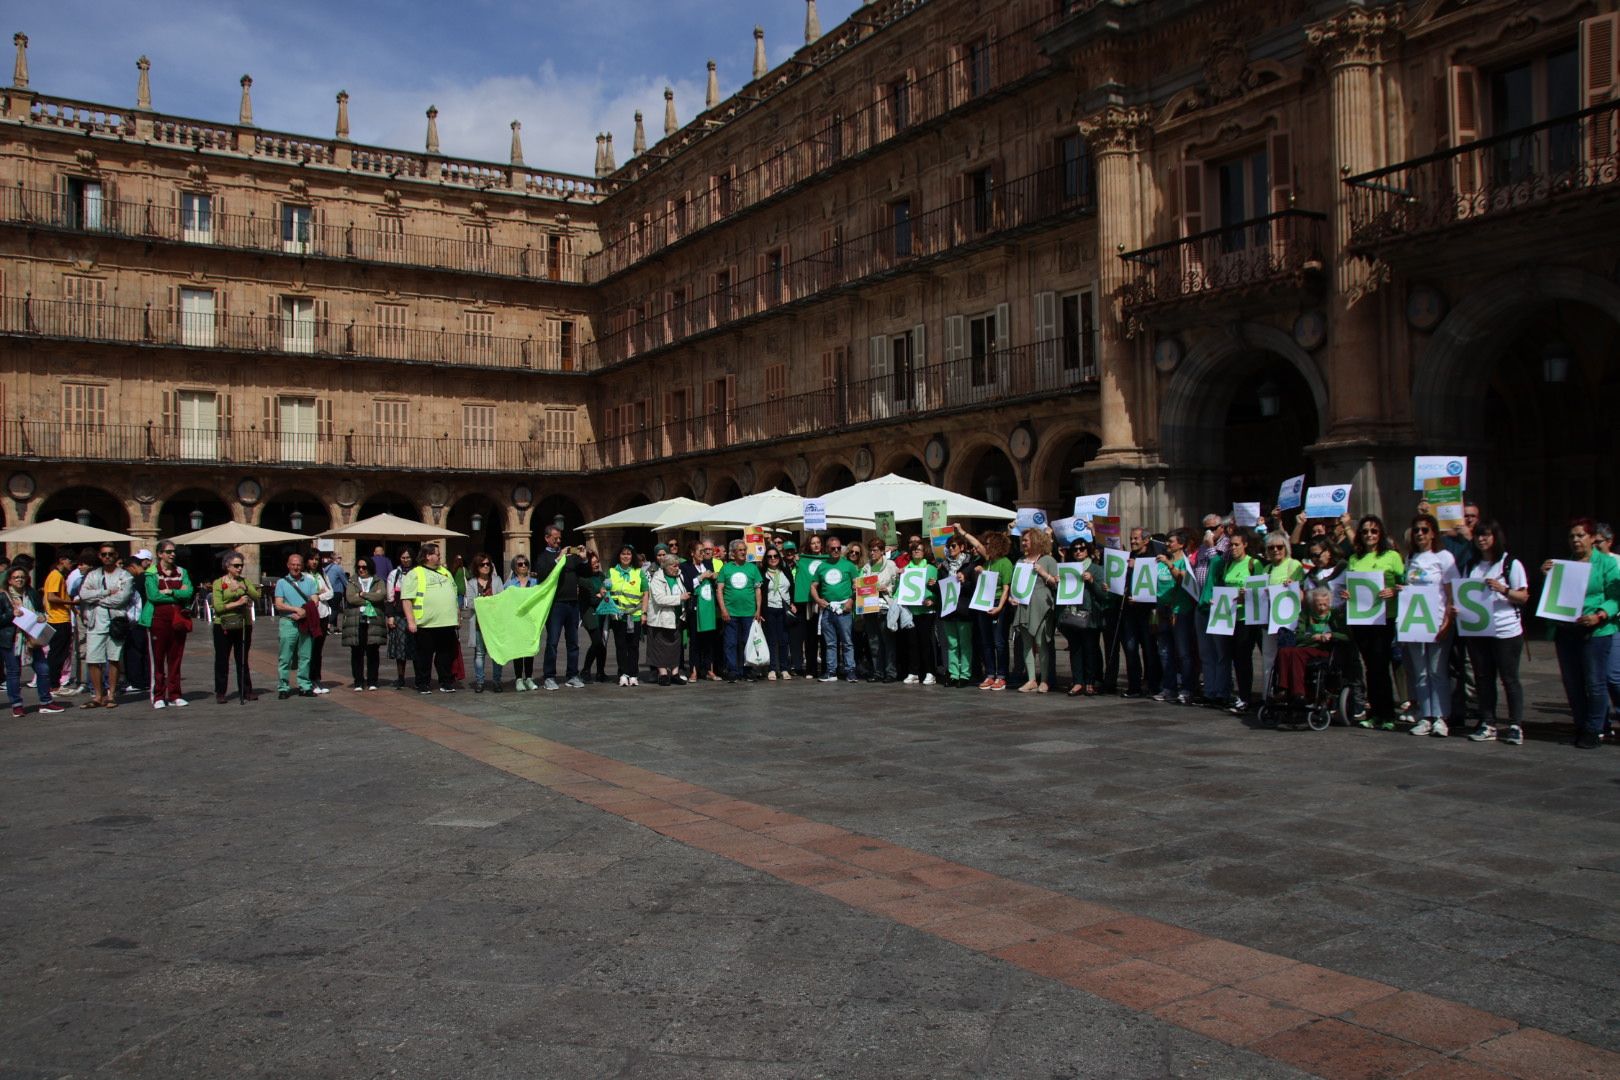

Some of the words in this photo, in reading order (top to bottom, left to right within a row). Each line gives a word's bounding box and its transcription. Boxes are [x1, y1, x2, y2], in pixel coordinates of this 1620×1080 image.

[1011, 563, 1037, 599] U
[1059, 568, 1084, 600] D
[1106, 554, 1125, 583] P
[1133, 564, 1156, 596] A
[902, 571, 924, 603] S
[943, 581, 958, 611] A
[976, 574, 991, 606] L
[1246, 580, 1266, 621] T
[1348, 578, 1382, 619] D
[1544, 563, 1577, 616] L
[1209, 594, 1234, 628] A
[1272, 590, 1301, 625] O
[1399, 594, 1436, 633] A
[1457, 581, 1490, 632] S
